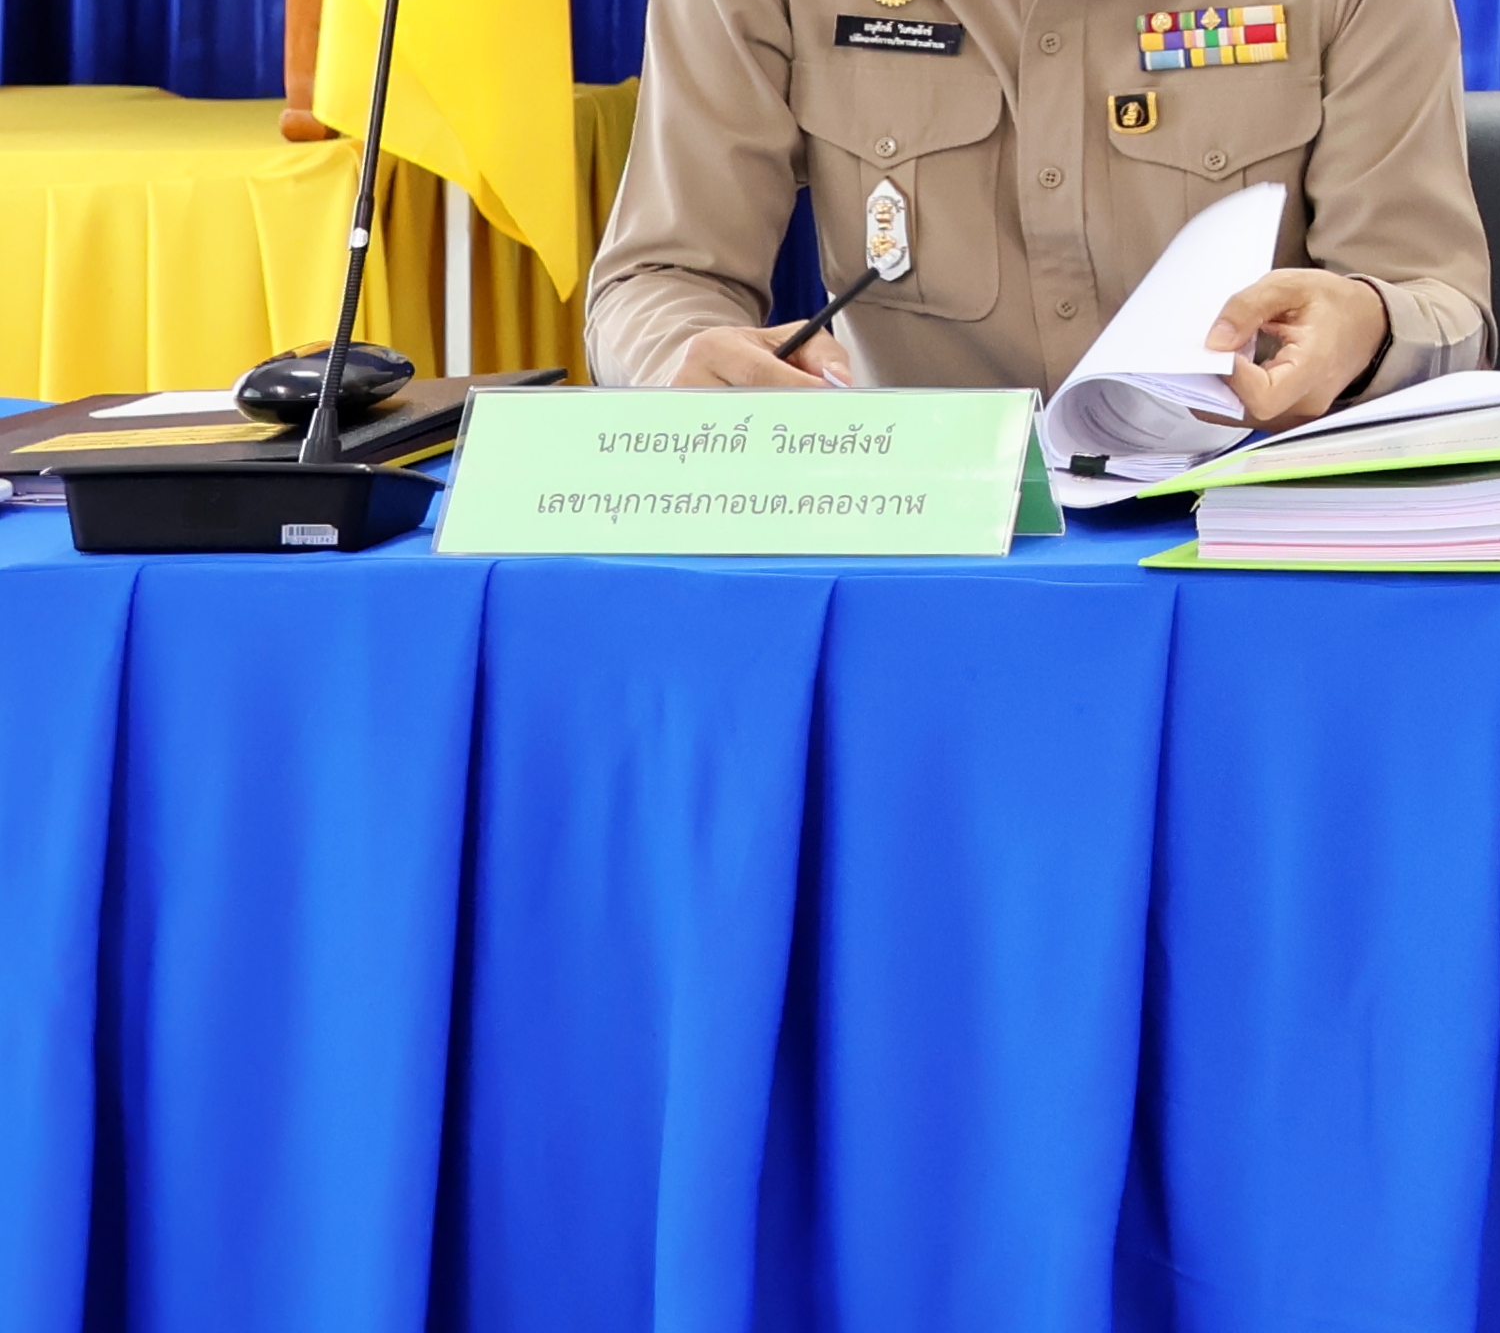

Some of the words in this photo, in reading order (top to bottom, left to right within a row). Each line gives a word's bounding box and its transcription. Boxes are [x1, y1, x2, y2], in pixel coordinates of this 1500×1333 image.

[597, 414, 754, 464] นายอนุศักดิ์
[770, 422, 897, 456] วิเศษสังข์
[536, 491, 928, 526] เลขานุการสภาอบต.คลองวาฬ
